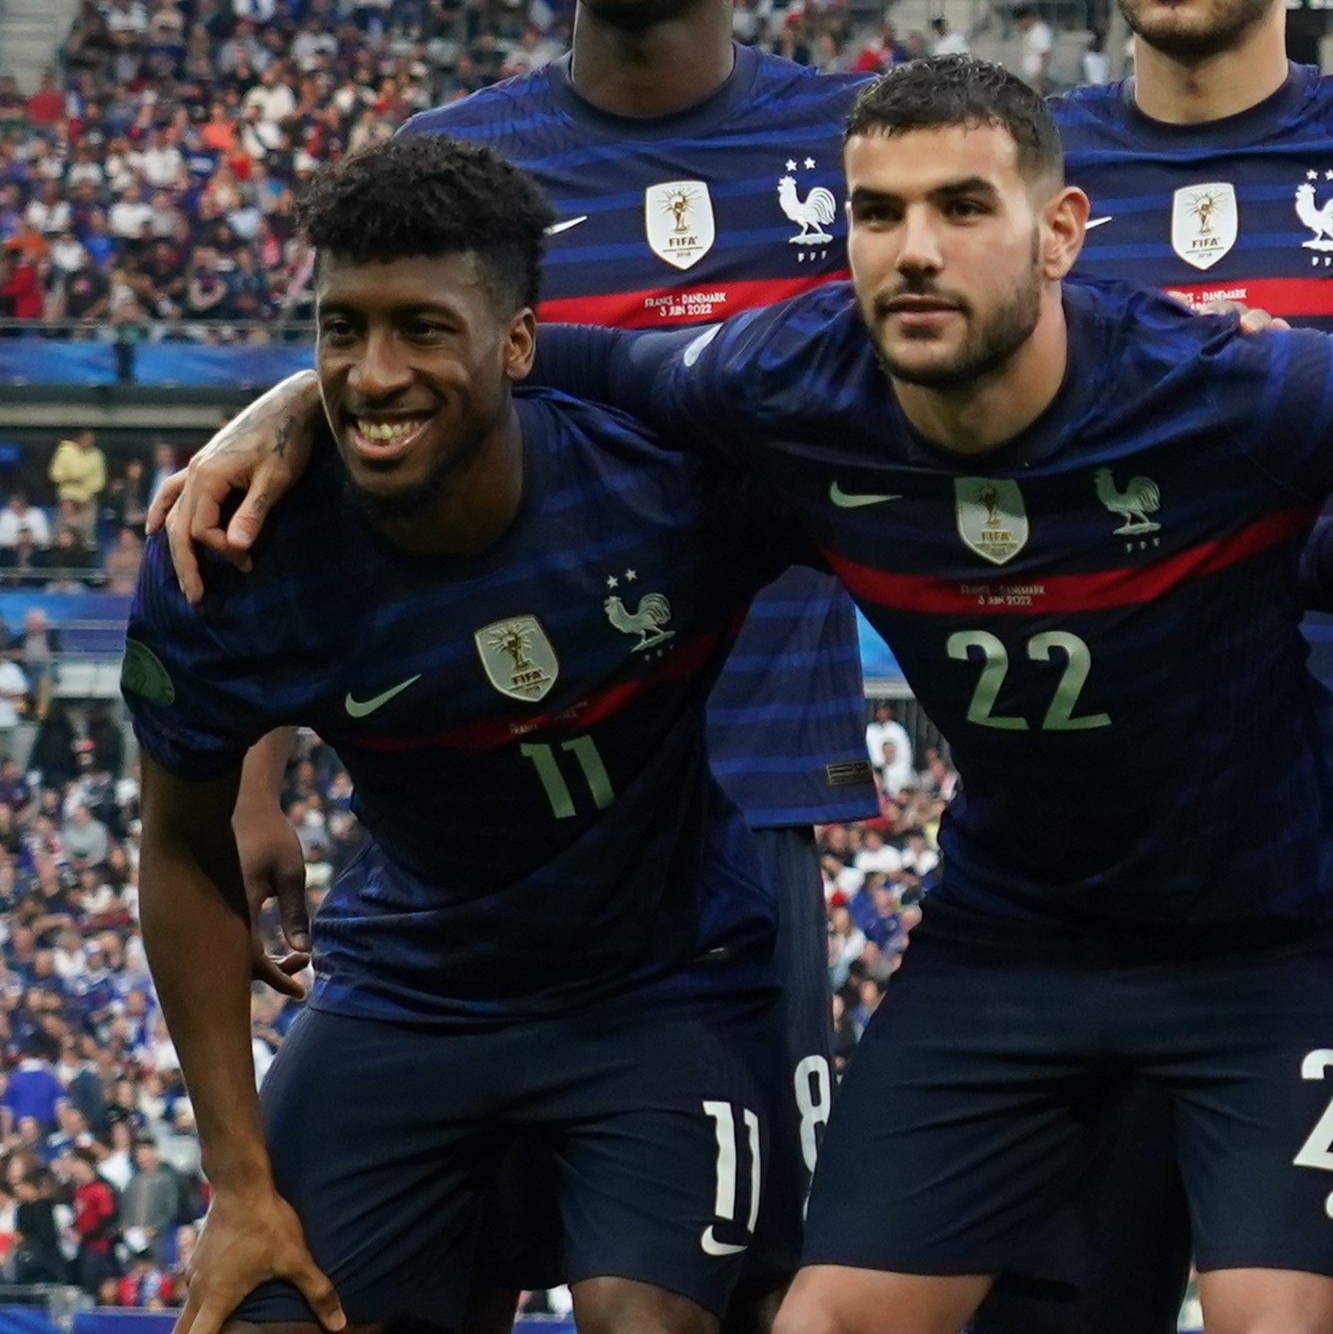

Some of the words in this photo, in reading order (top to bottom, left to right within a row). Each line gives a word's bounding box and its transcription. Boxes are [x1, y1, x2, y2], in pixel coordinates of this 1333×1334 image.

[669, 235, 698, 247] FIFA
[1192, 238, 1218, 248] FIFA
[681, 292, 727, 304] DANEMARK
[687, 303, 712, 315] 2022
[981, 531, 1010, 542] FIFA
[512, 669, 544, 685] FIFA
[946, 630, 1112, 730] 22
[519, 734, 617, 819] 11
[702, 1100, 761, 1234] 11
